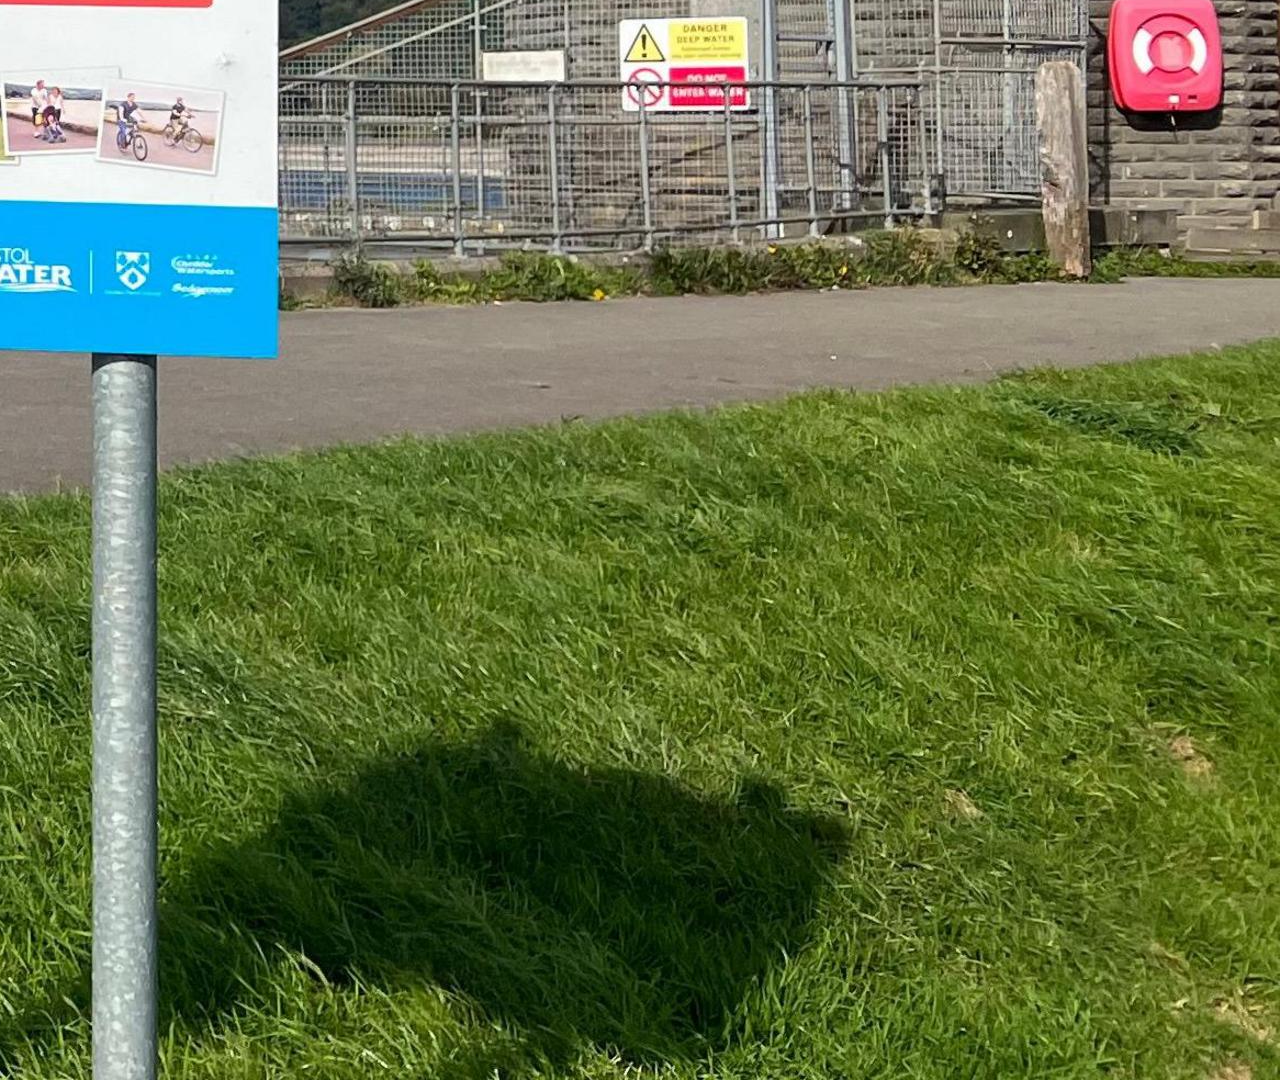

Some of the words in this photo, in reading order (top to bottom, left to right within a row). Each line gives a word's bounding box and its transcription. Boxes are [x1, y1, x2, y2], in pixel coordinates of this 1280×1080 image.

[683, 24, 727, 32] DANGER
[677, 35, 700, 43] DEEP
[703, 34, 735, 42] WATER
[708, 86, 743, 98] WAER
